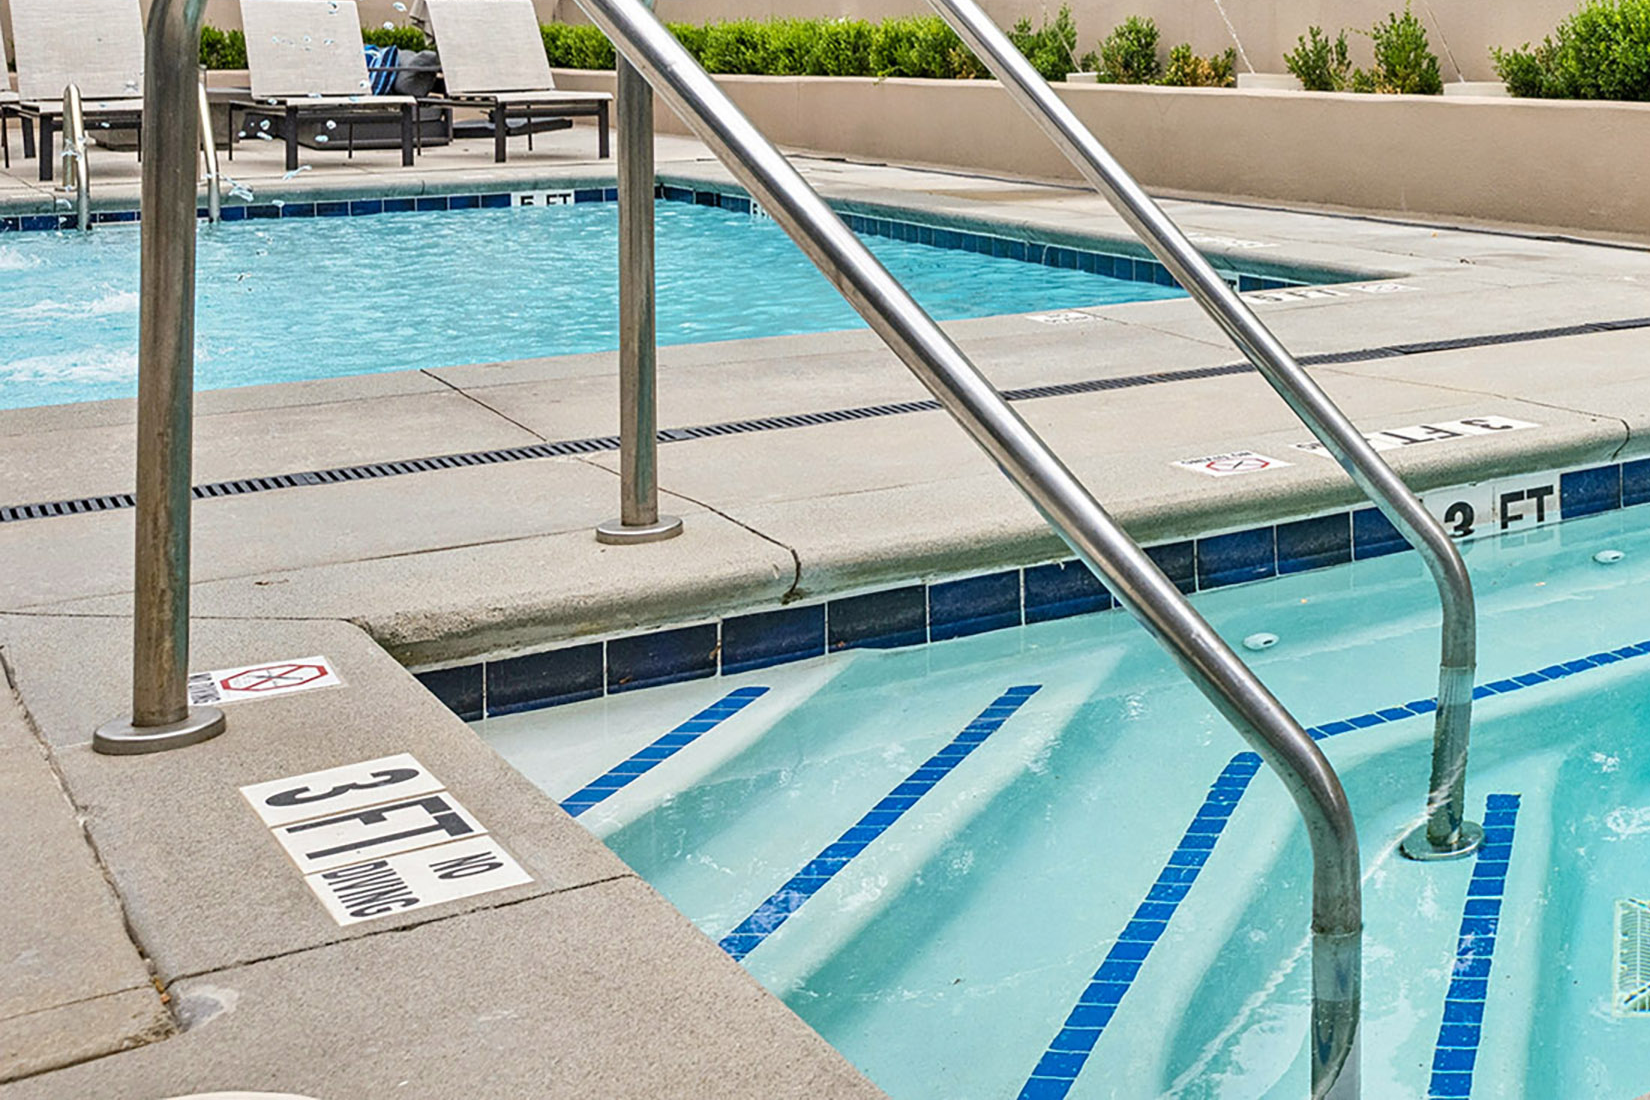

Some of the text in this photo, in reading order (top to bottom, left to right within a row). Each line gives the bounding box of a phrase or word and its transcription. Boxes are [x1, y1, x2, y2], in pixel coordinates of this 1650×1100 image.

[1443, 484, 1554, 538] 3 FT
[265, 767, 475, 861] 3 FT
[321, 860, 420, 918] DIVING
[428, 851, 505, 881] NO
